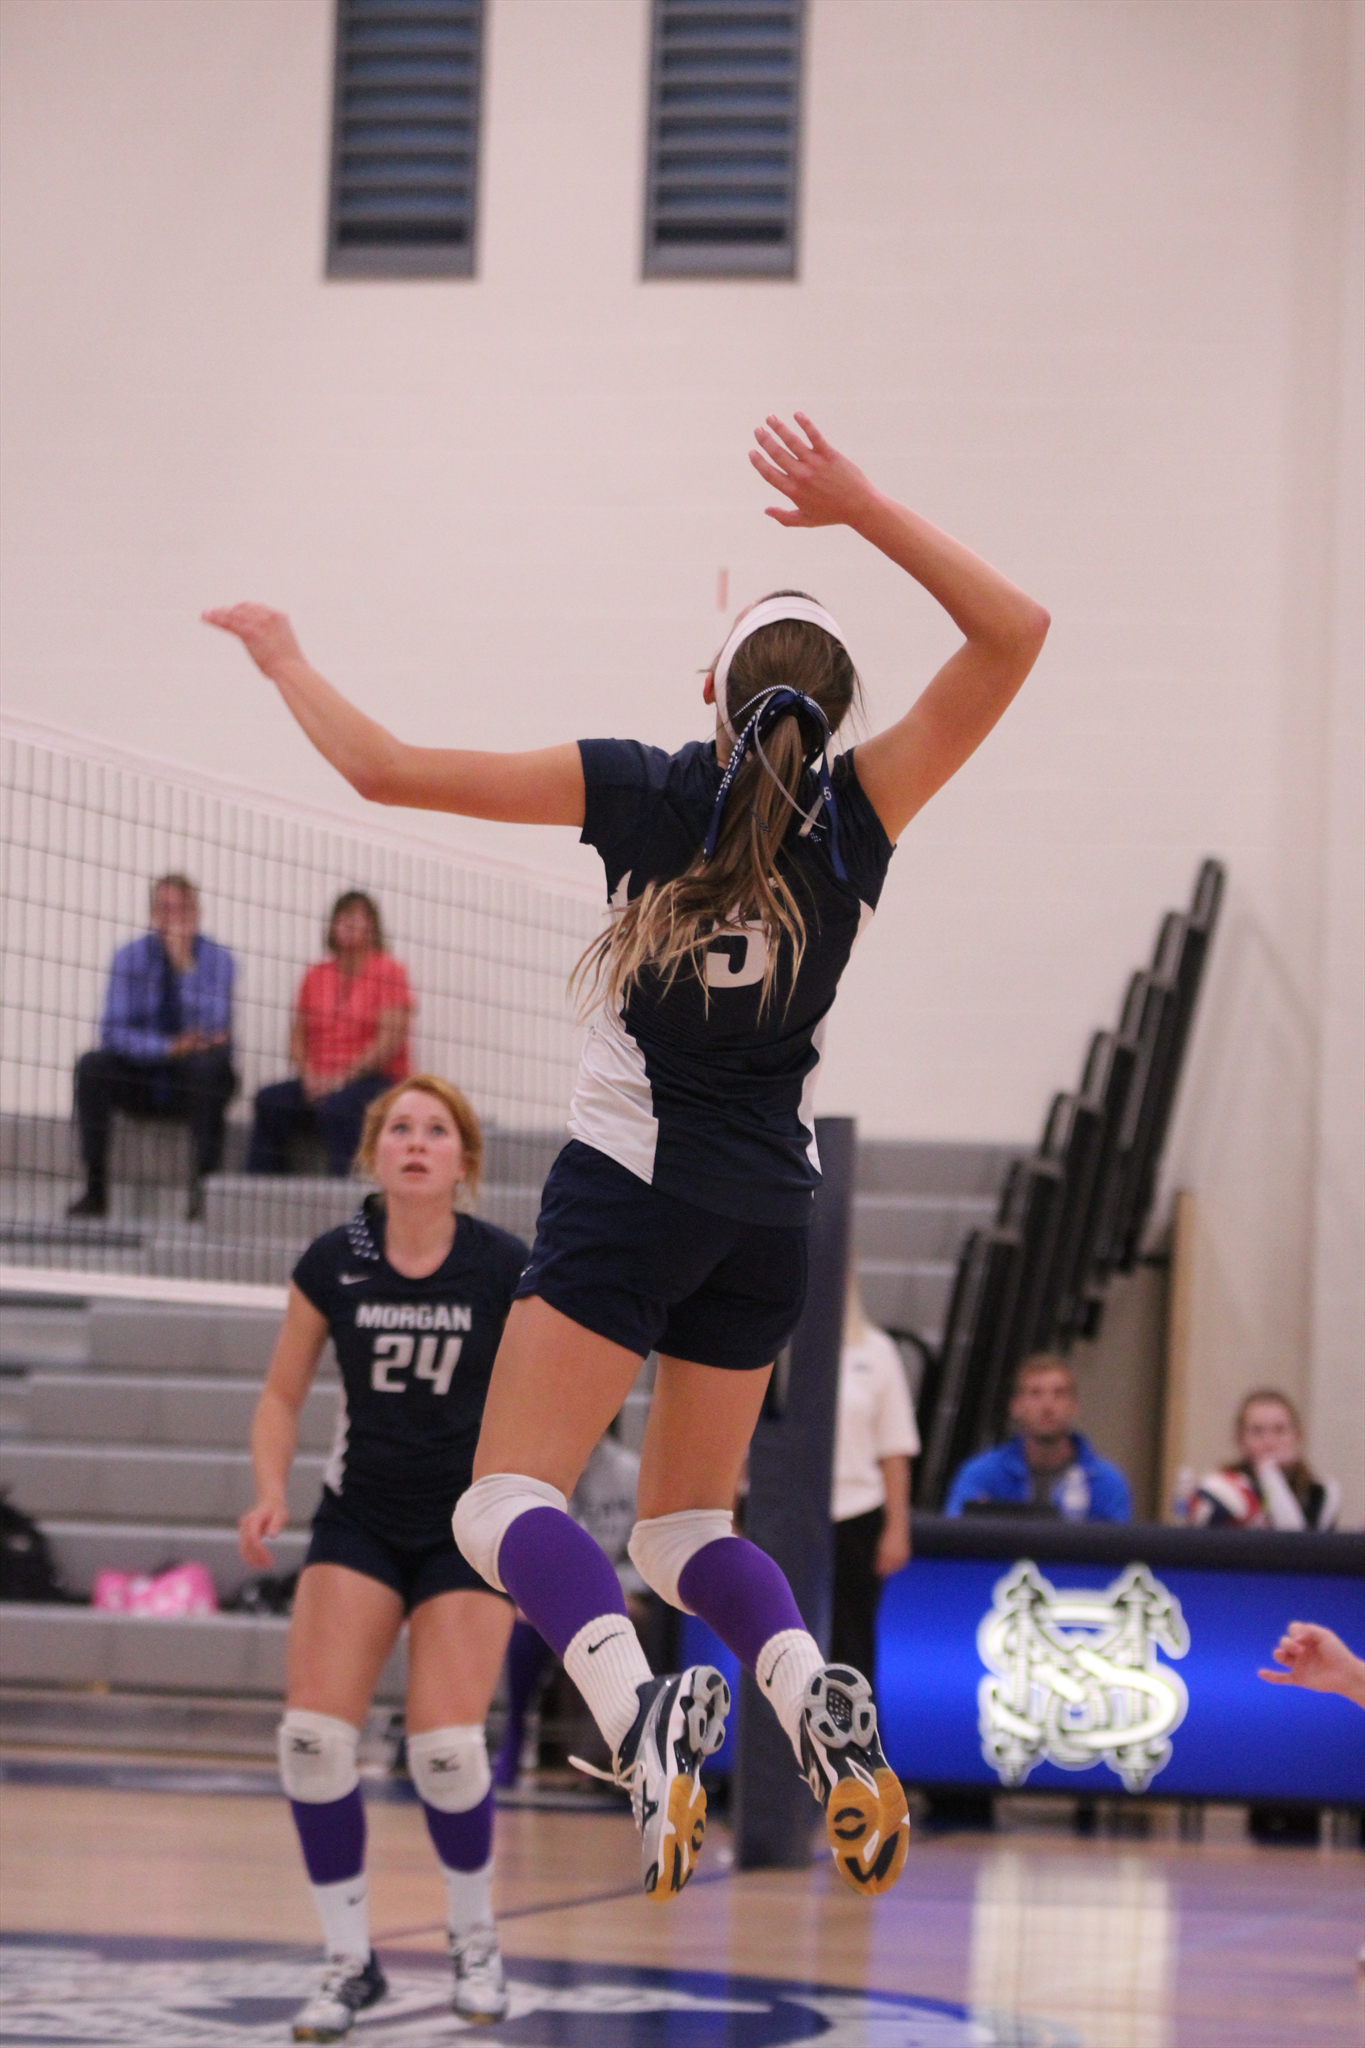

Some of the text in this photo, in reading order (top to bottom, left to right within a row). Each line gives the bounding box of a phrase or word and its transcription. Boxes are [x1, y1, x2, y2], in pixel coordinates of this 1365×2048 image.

[823, 786, 832, 801] 5
[704, 879, 779, 988] 5
[356, 1305, 472, 1331] MORGAN
[371, 1335, 462, 1395] 24
